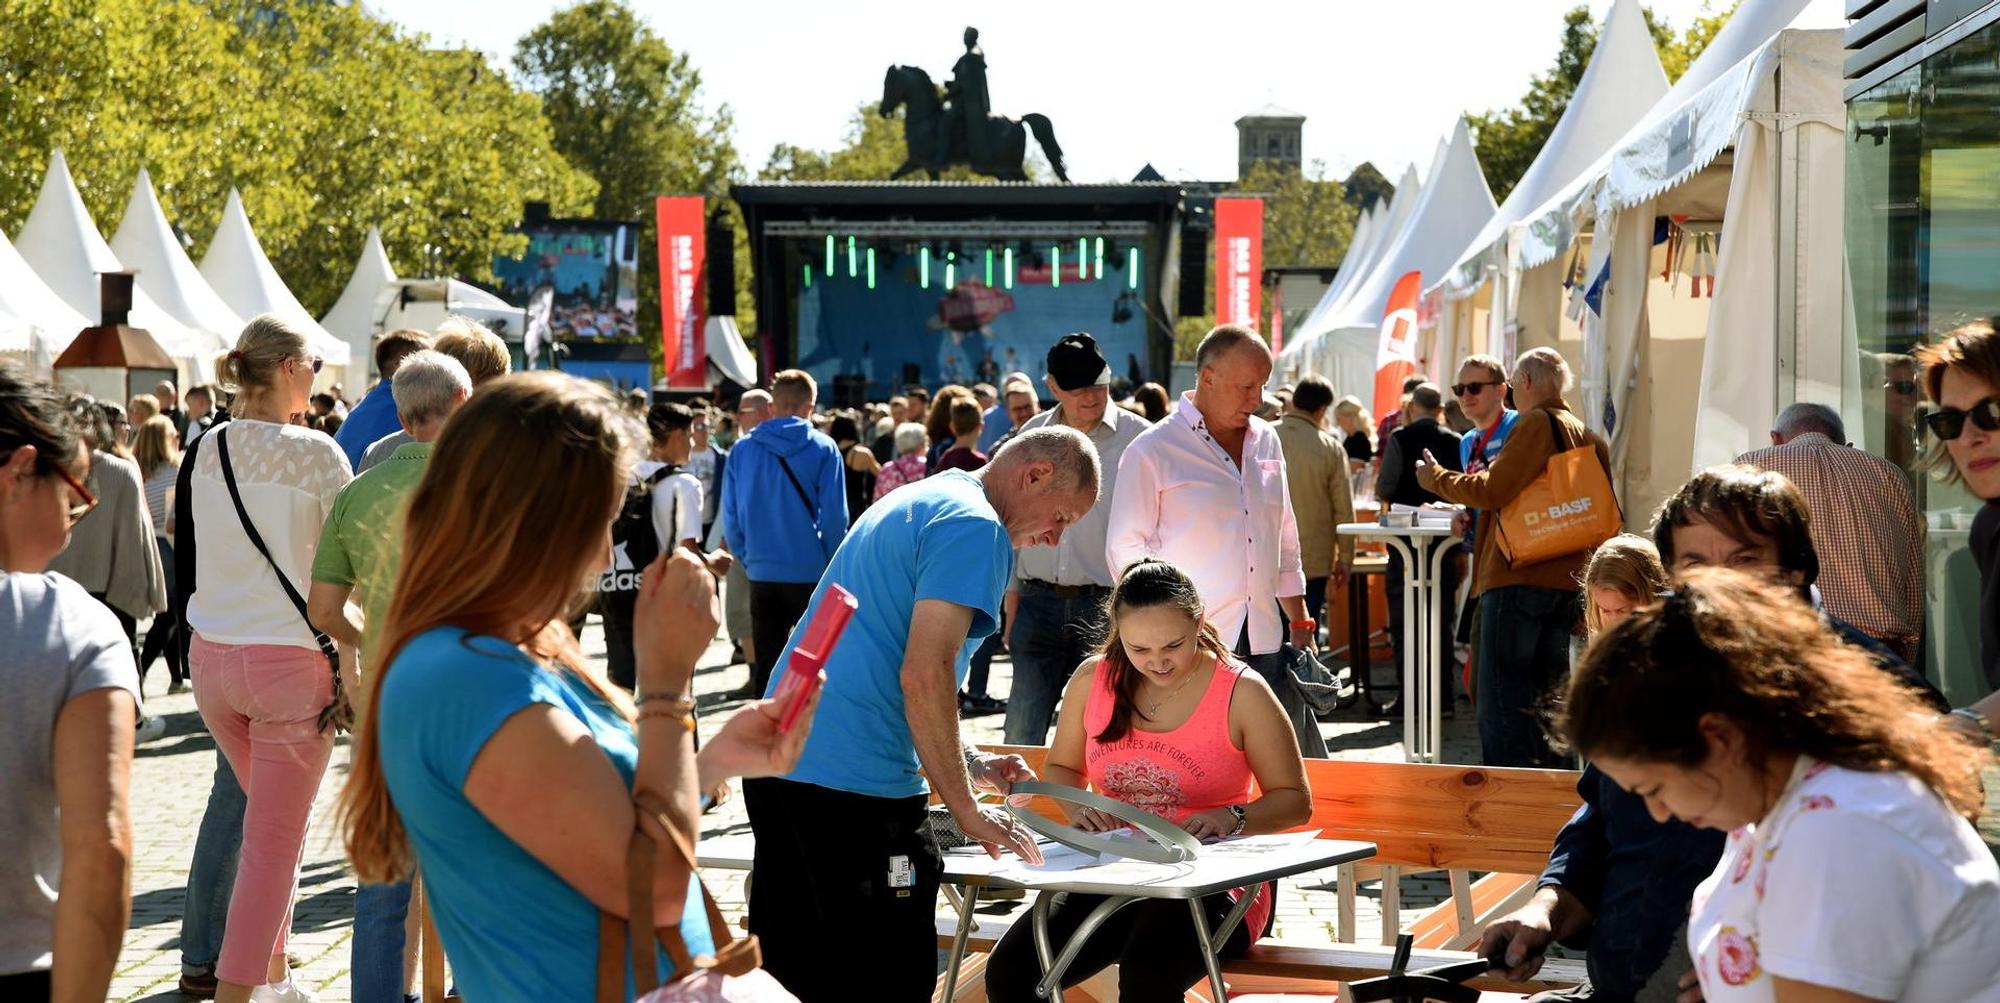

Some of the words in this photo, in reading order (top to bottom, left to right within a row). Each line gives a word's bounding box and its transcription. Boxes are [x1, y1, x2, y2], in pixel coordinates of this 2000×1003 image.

[678, 235, 692, 271] DAS
[1235, 236, 1250, 273] DAS
[1548, 496, 1592, 519] BASF
[581, 569, 644, 592] didas
[1089, 739, 1144, 764] ADVENTURES
[1146, 741, 1166, 754] ARE
[1167, 746, 1206, 781] FOREVER
